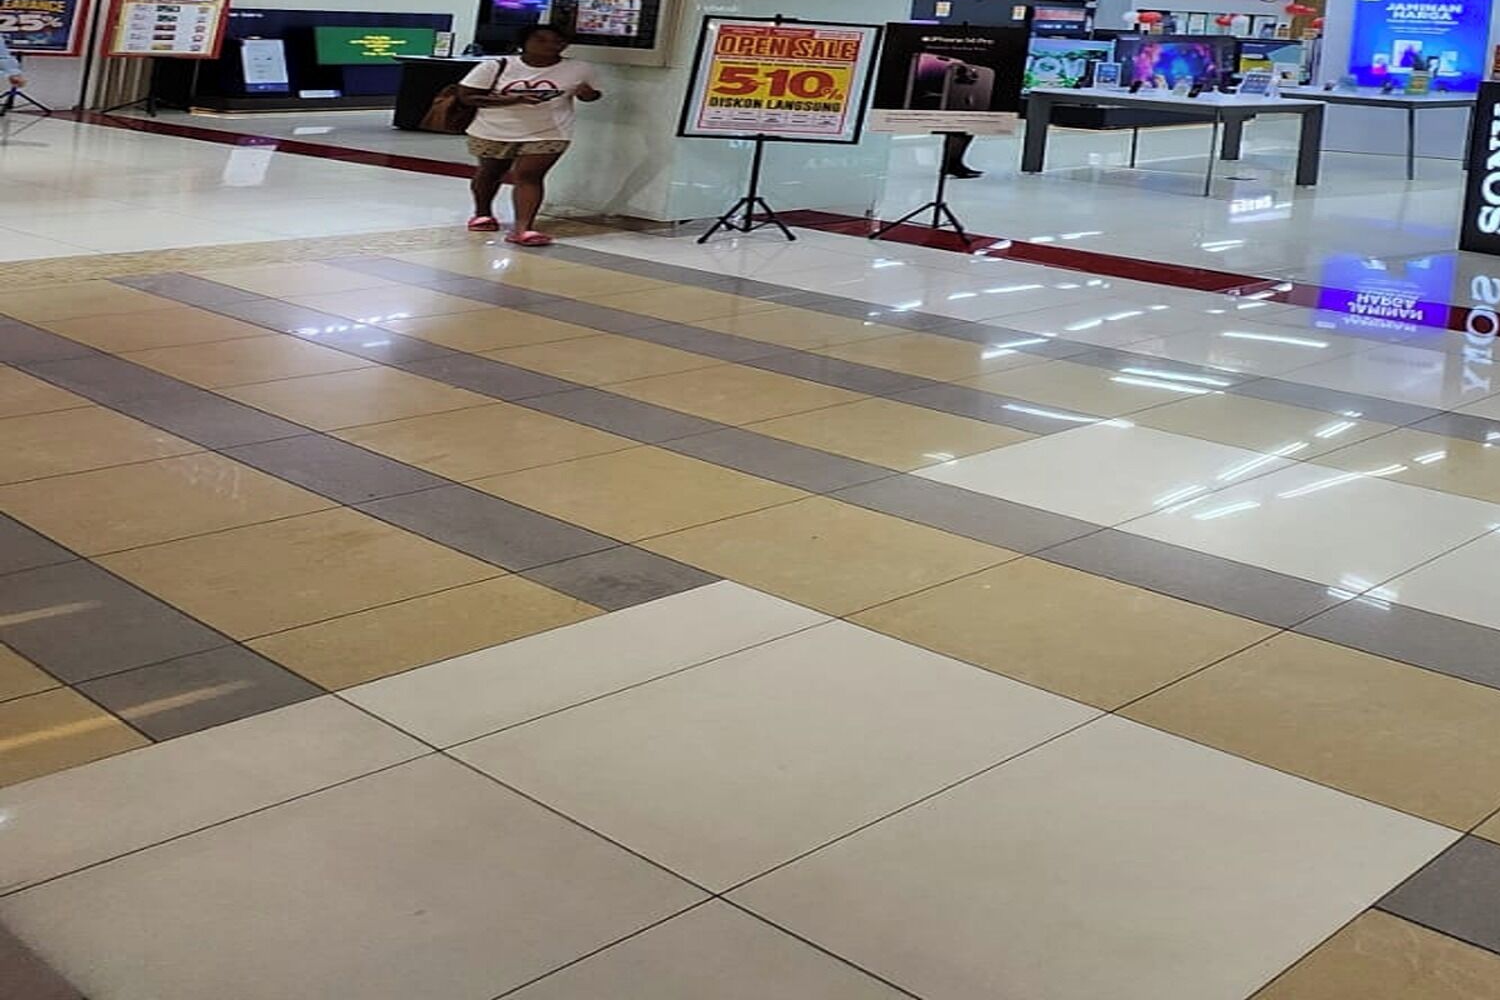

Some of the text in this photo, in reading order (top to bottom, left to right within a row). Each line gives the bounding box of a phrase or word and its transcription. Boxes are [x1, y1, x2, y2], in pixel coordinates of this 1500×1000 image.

[0, 14, 63, 32] 25%
[719, 34, 859, 61] OPEN SALE
[708, 96, 763, 110] DISKON
